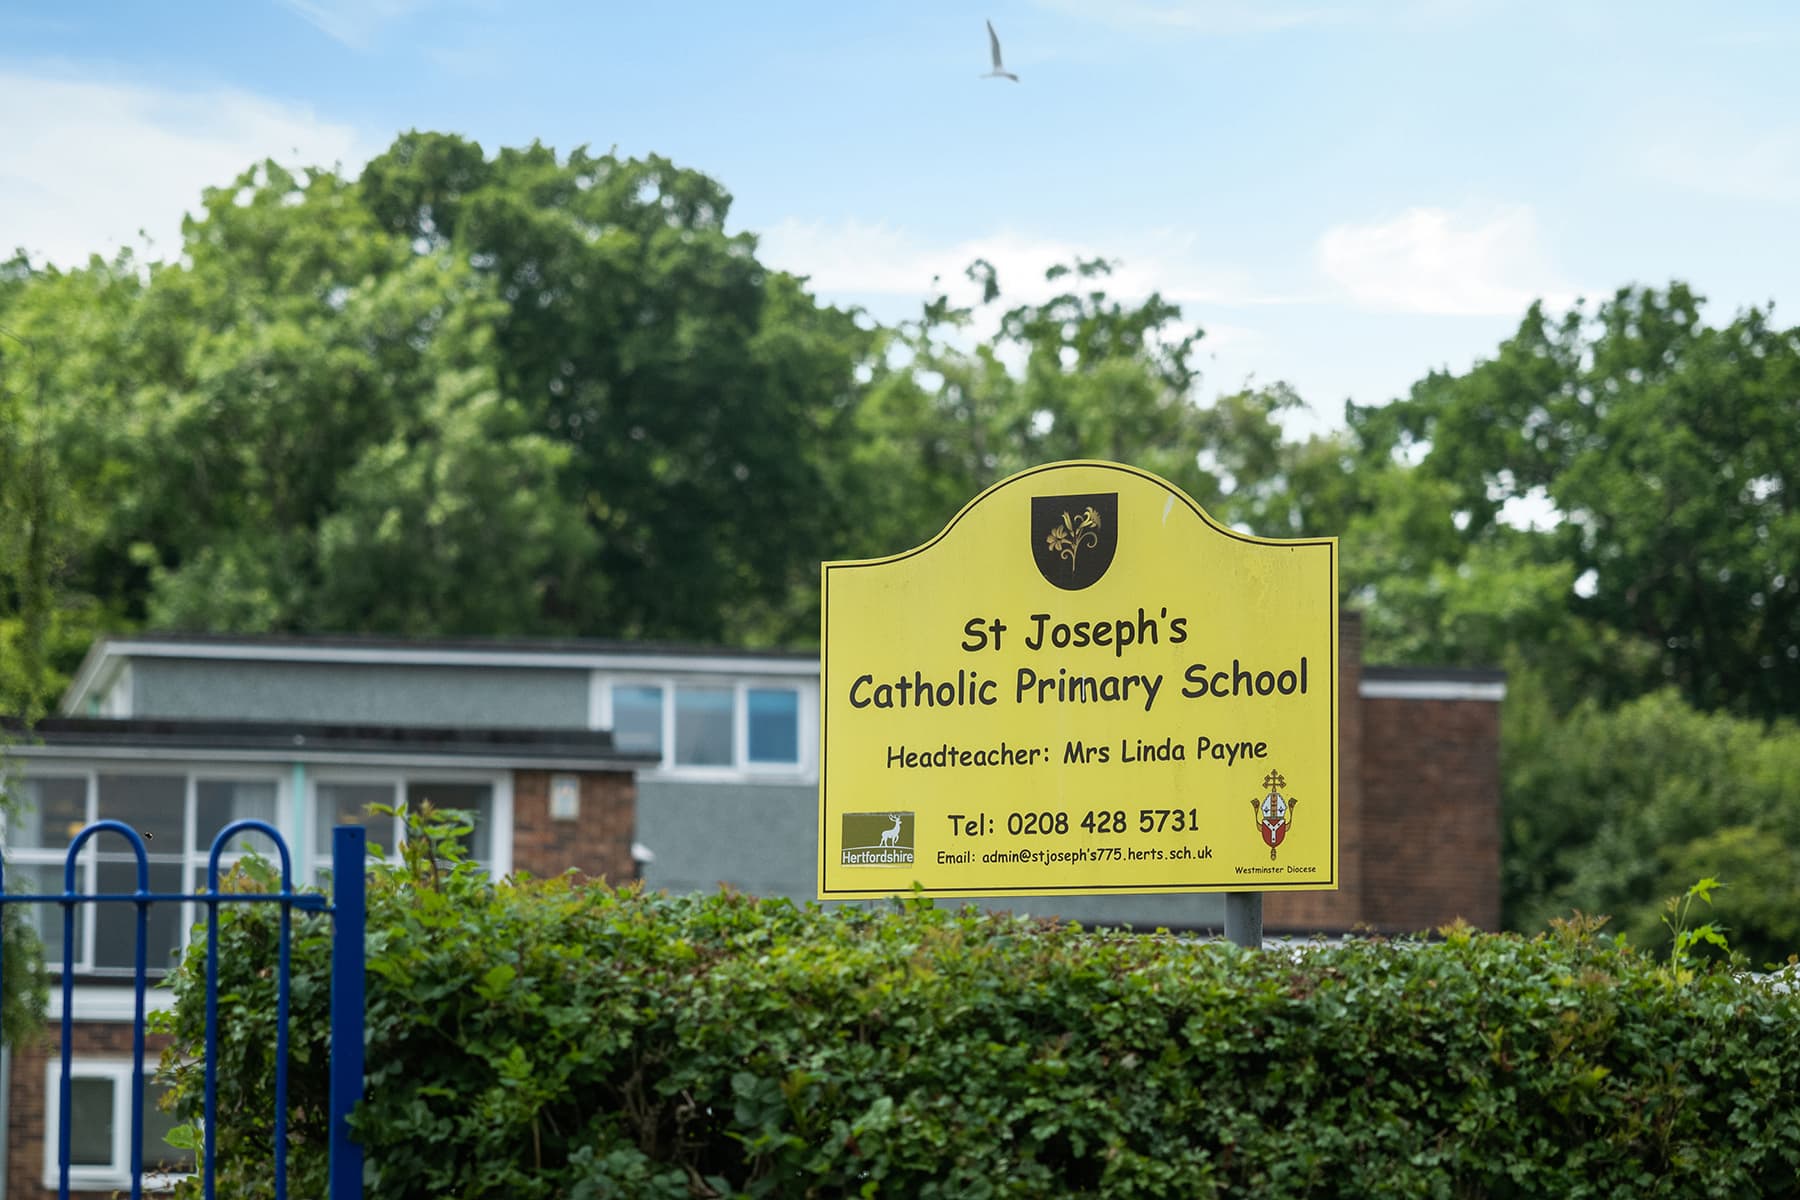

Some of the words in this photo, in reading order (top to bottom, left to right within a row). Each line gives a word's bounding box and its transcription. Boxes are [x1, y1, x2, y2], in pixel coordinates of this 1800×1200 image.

[962, 618, 1007, 652] St
[1025, 607, 1187, 657] Joseph's
[850, 670, 997, 708] Catholic
[1017, 668, 1163, 711] Primary
[1182, 657, 1307, 698] School
[887, 742, 1048, 768] Headteacher:
[1064, 741, 1109, 764] Mrs
[1122, 737, 1185, 763] Linda
[1198, 737, 1267, 766] Payne
[948, 813, 993, 836] Tel:
[1008, 812, 1069, 835] 0208
[1081, 811, 1126, 833] 428
[1140, 809, 1198, 833] 5731
[842, 849, 913, 864] Hertfordshire
[937, 851, 975, 864] Email:
[983, 846, 1212, 865] admin@stjoseph's775.herts.sch.uk
[1234, 865, 1284, 874] Westminster
[1287, 865, 1317, 874] Diocese
